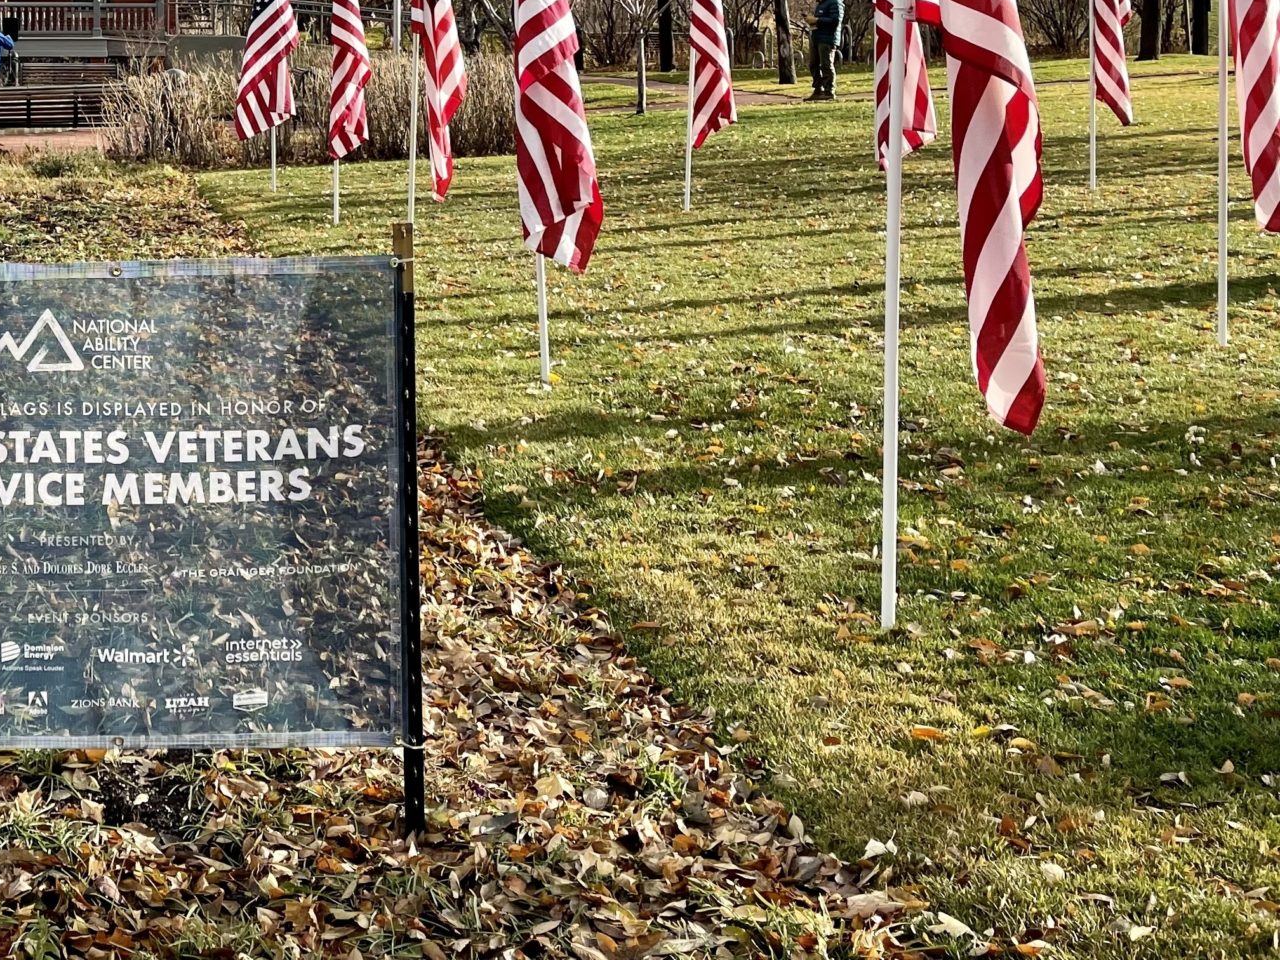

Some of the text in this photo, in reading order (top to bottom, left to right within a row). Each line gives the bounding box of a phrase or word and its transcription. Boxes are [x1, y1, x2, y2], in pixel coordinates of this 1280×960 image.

[73, 319, 158, 334] NATIONAL
[82, 337, 140, 351] ABILITY
[91, 355, 151, 369] CENTER
[57, 402, 73, 416] IS
[82, 402, 182, 416] DISPLAYED
[192, 402, 211, 416] IN
[221, 400, 293, 415] HONOR
[302, 398, 326, 413] OF
[144, 425, 365, 464] VETERANS
[102, 467, 312, 505] MEMBERS
[40, 535, 134, 546] PRESENTED BY
[23, 564, 40, 574] AND
[43, 562, 83, 574] DOLORES
[182, 564, 359, 578] THE GRAINGER FOUNDATION
[28, 612, 148, 623] EVENT SPONSORS
[24, 644, 64, 652] Dominion
[226, 637, 289, 651] internet
[24, 651, 55, 660] Energy
[98, 648, 170, 663] Walmart
[225, 649, 302, 663] essentials
[71, 697, 141, 709] ZIONS BANK
[165, 696, 210, 709] UTAH
